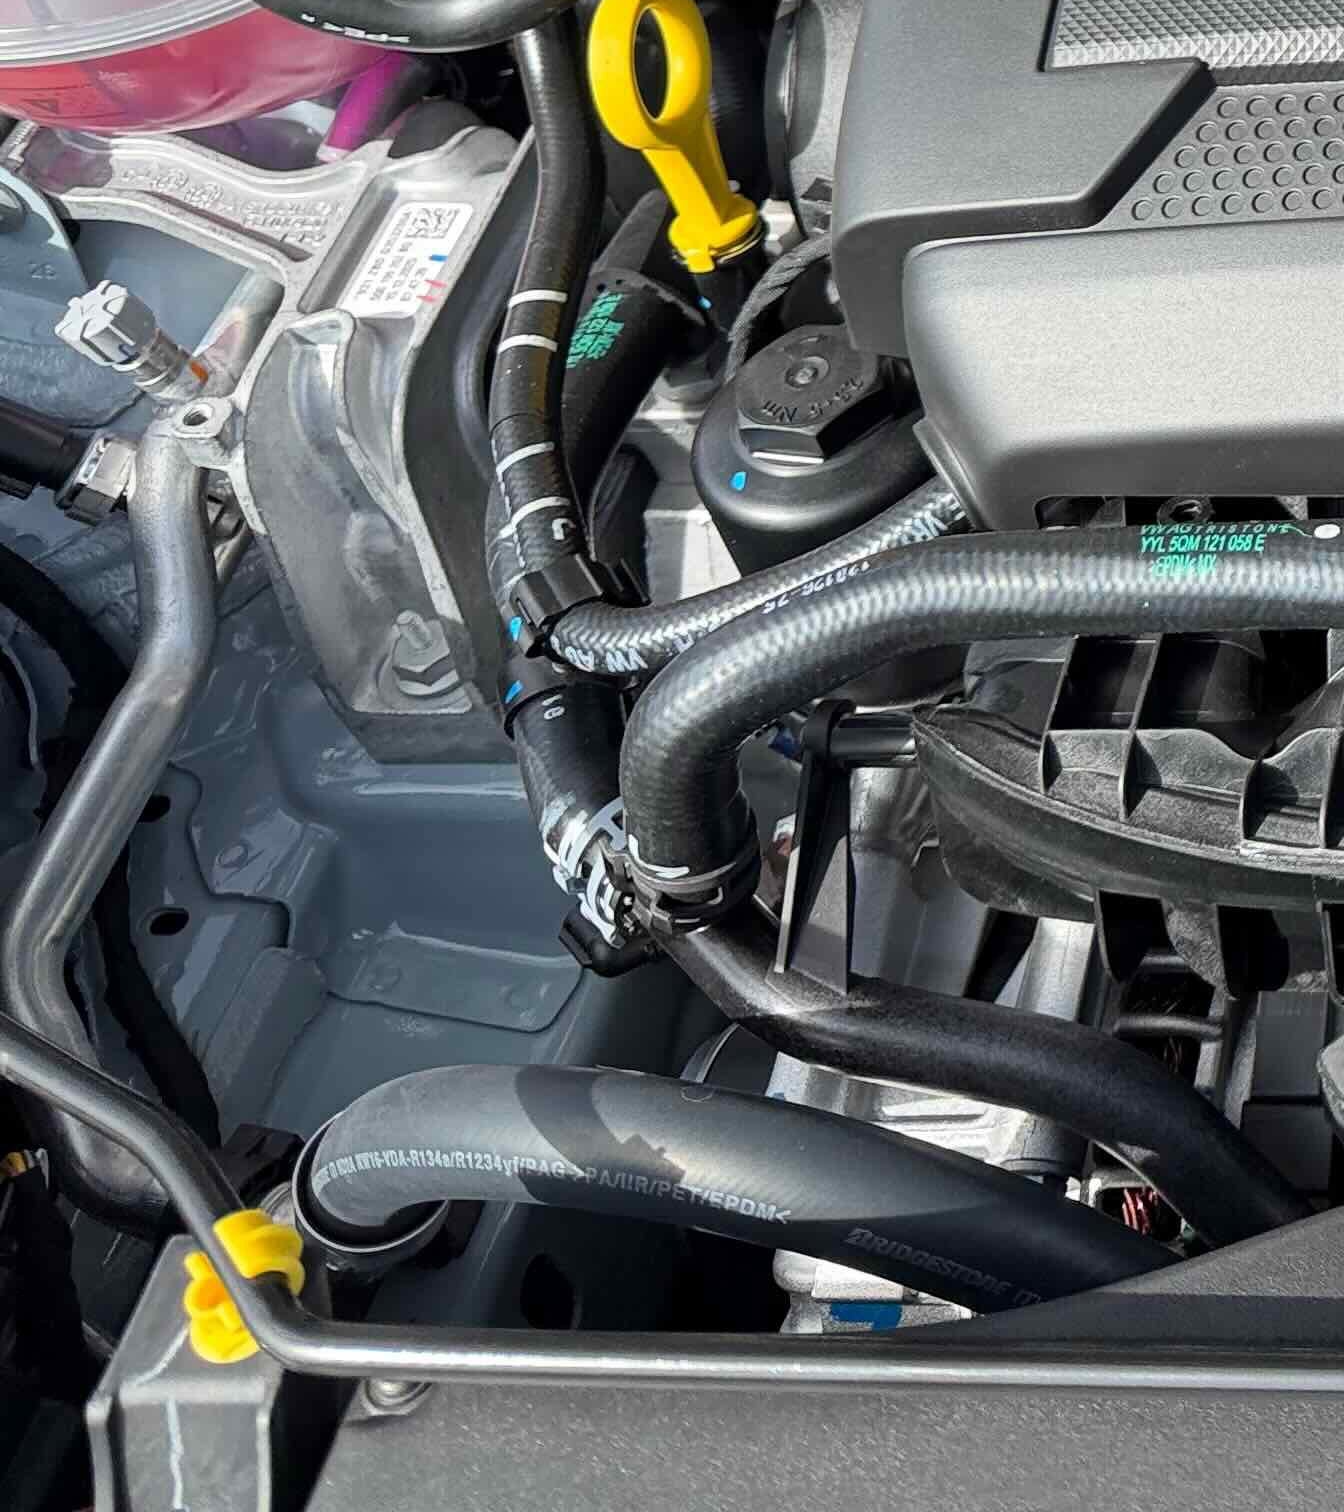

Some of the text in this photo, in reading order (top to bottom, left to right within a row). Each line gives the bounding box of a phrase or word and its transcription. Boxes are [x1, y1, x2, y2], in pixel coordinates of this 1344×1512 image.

[1140, 534, 1267, 552] YYL 5QM 121 058 E
[606, 648, 648, 673] VW
